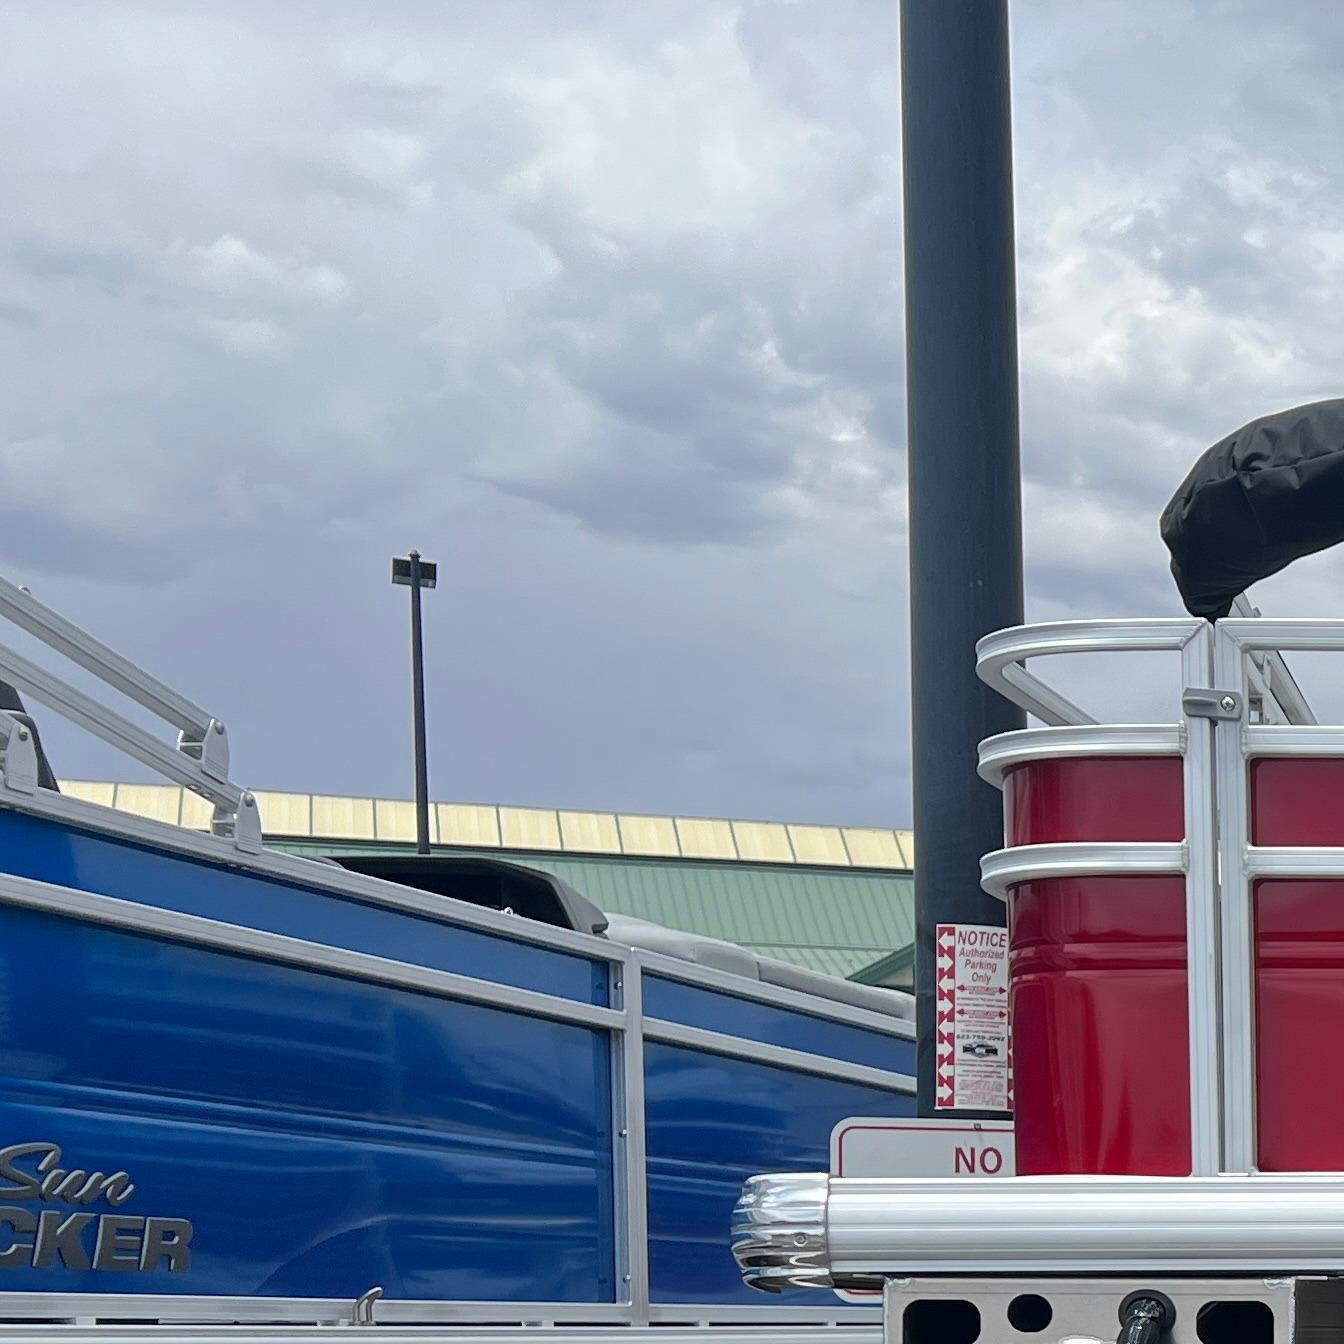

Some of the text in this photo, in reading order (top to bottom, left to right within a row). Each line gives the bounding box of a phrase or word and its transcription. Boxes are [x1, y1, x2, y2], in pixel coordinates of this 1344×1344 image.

[958, 930, 1008, 948] NOTICE
[959, 947, 1005, 960] Authorized
[964, 959, 997, 973] Parking
[971, 972, 992, 985] Only
[955, 1146, 1003, 1174] NO
[0, 1142, 135, 1206] Sun
